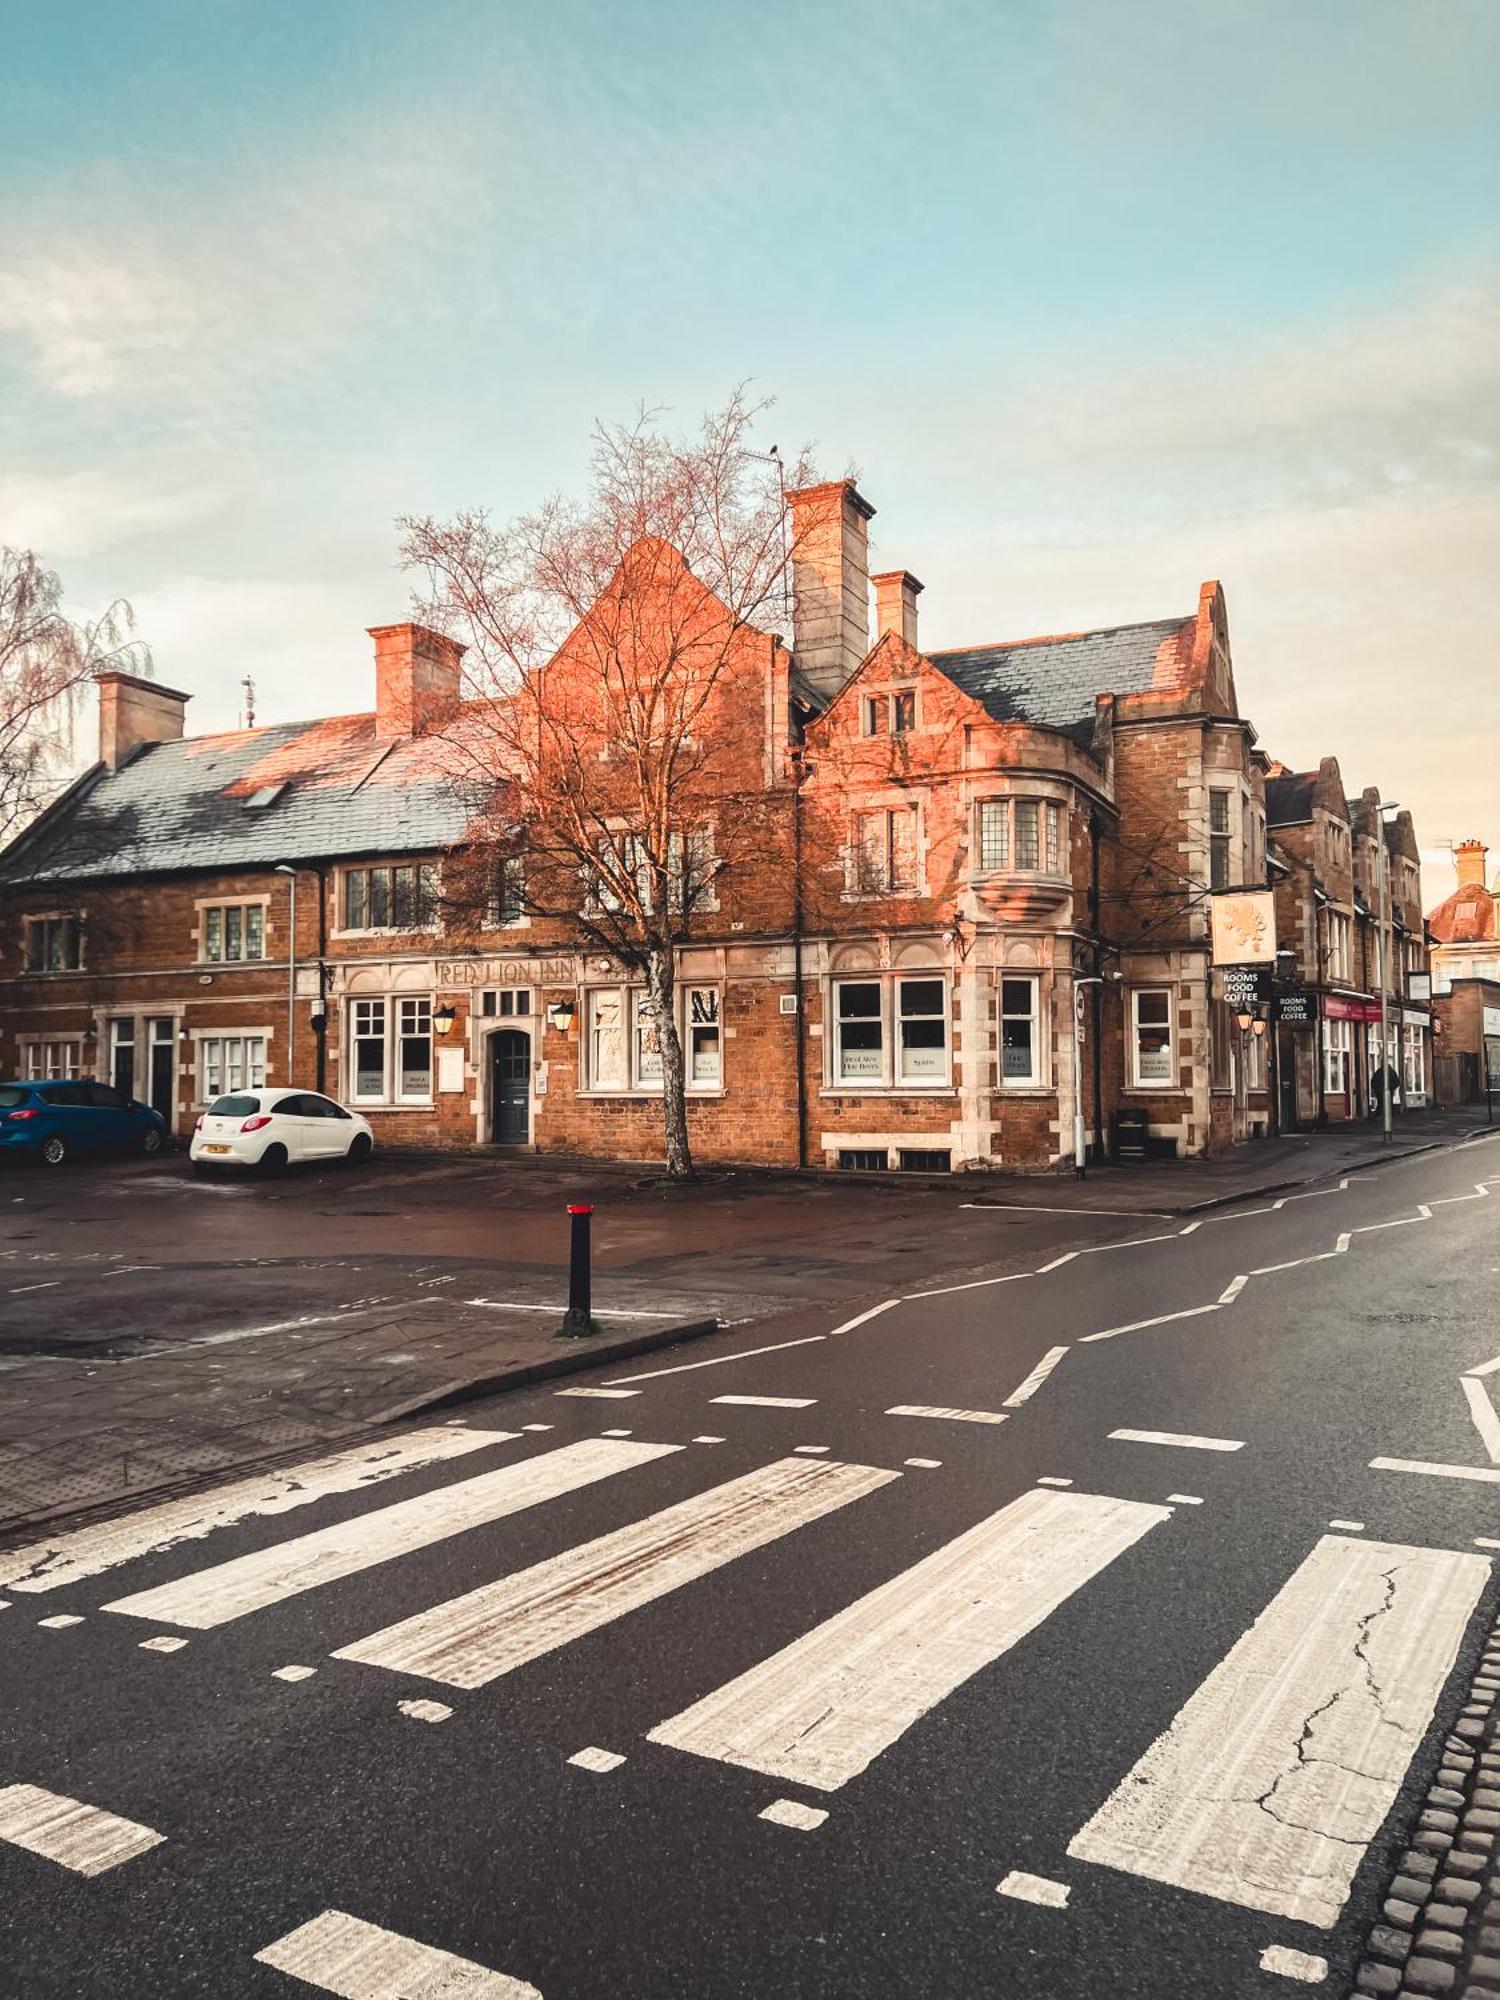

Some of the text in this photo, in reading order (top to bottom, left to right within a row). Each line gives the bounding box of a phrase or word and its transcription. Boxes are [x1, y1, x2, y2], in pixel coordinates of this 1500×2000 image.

[440, 960, 575, 985] RED LION INN
[1223, 973, 1258, 982] ROOMS
[1227, 983, 1254, 992] FOOD
[1223, 992, 1258, 1002] COFFEE
[1280, 997, 1307, 1005] ROOMS
